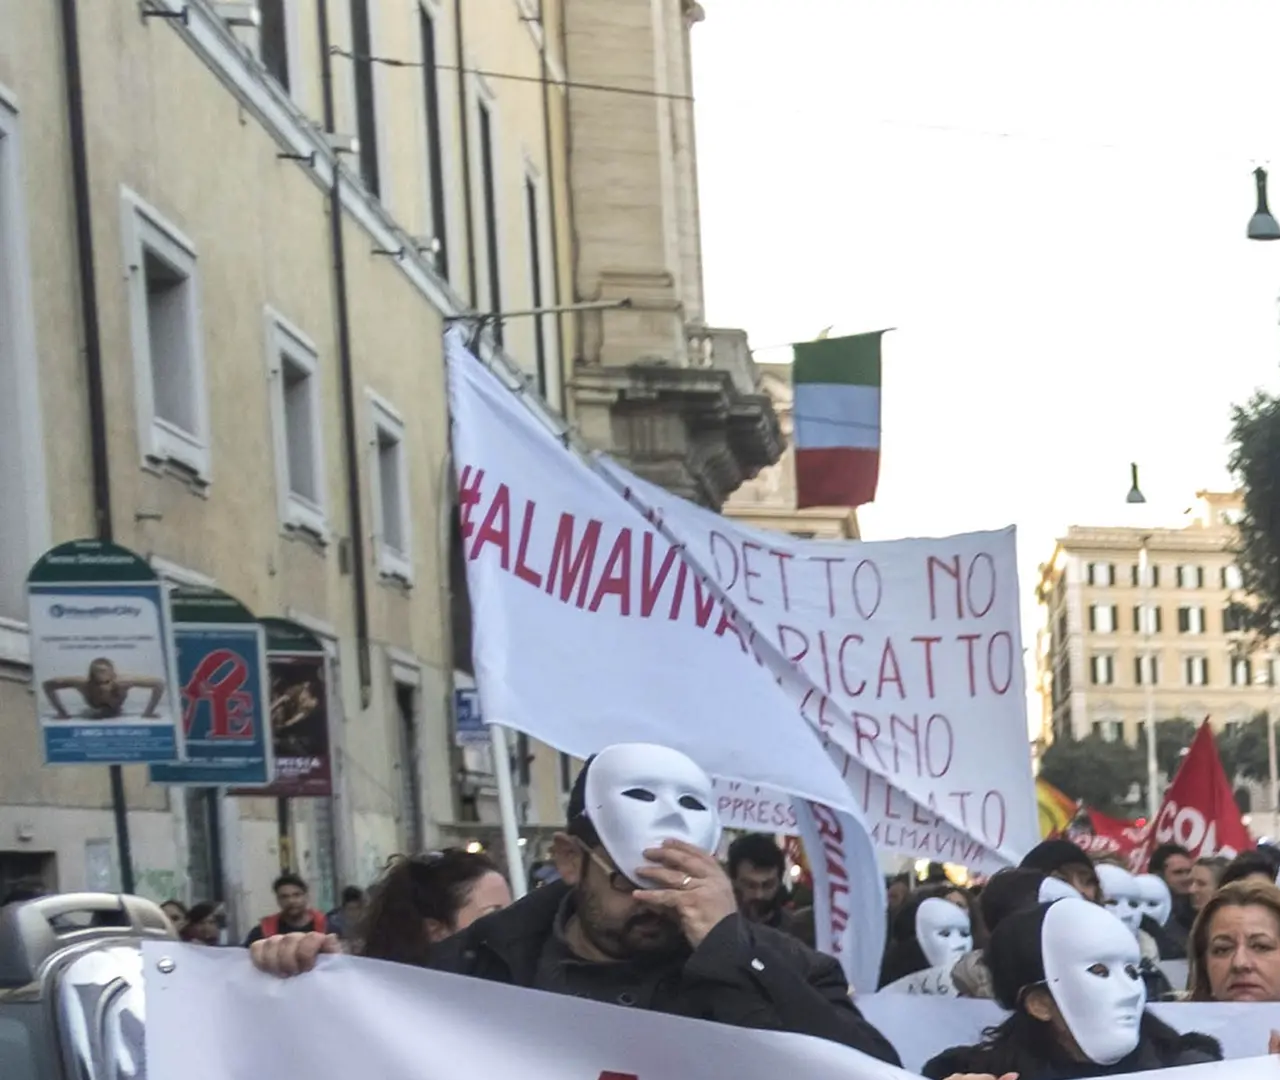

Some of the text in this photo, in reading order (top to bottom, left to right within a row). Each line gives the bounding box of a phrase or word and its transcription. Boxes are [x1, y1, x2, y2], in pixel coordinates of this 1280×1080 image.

[709, 529, 997, 621] DETTO NO
[717, 795, 798, 828] PPRESS
